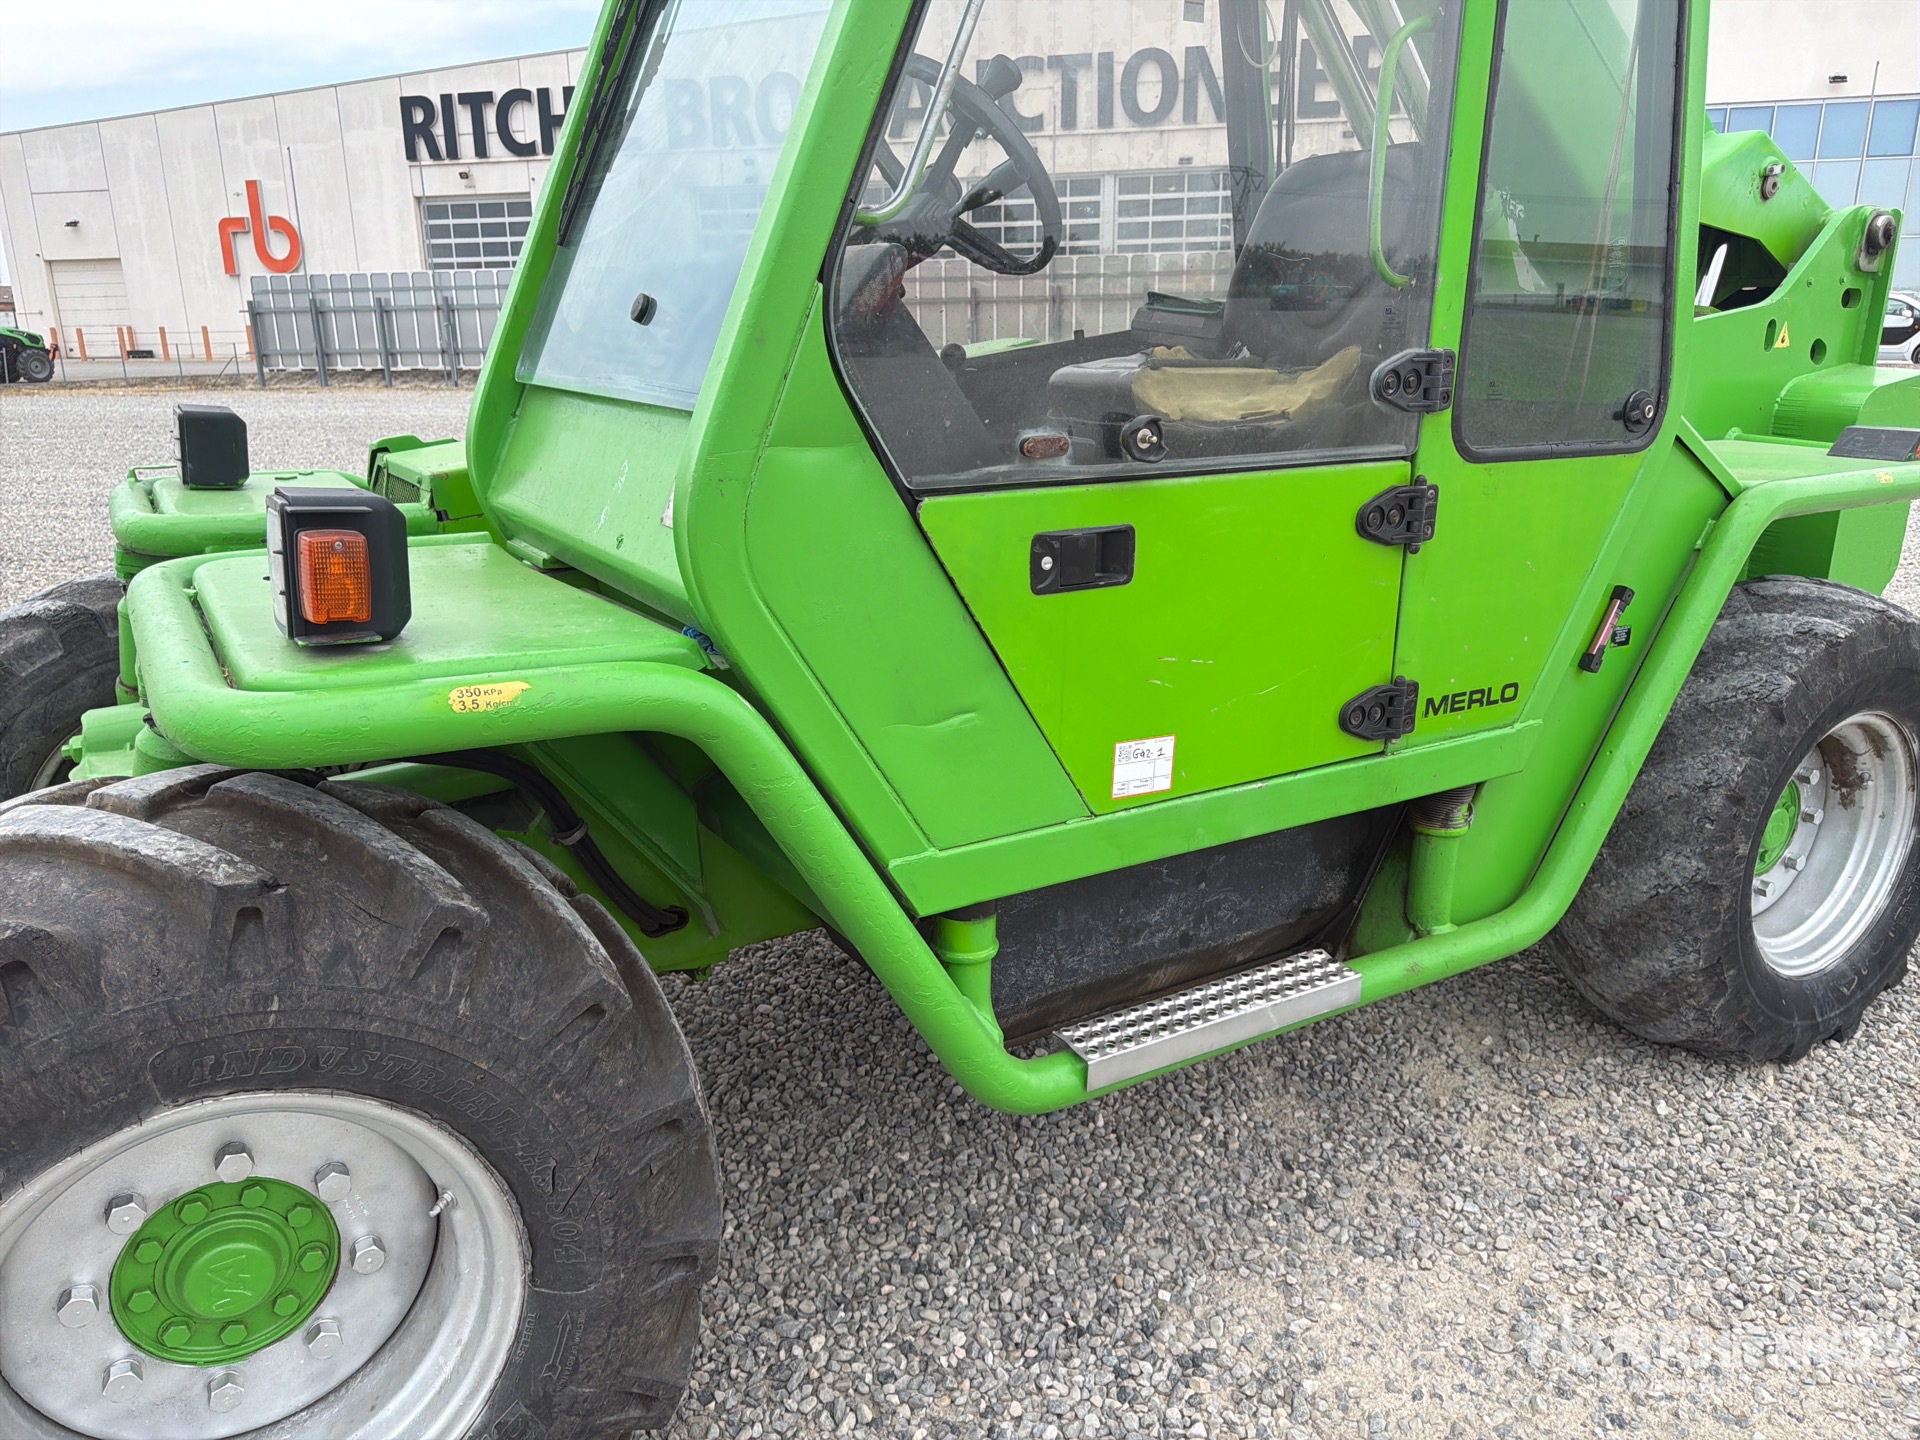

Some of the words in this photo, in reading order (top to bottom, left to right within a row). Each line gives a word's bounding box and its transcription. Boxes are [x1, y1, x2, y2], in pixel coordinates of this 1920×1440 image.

[218, 180, 302, 275] rb
[456, 687, 482, 699] 350
[458, 699, 480, 711] 3.5
[1423, 682, 1519, 719] MERLO
